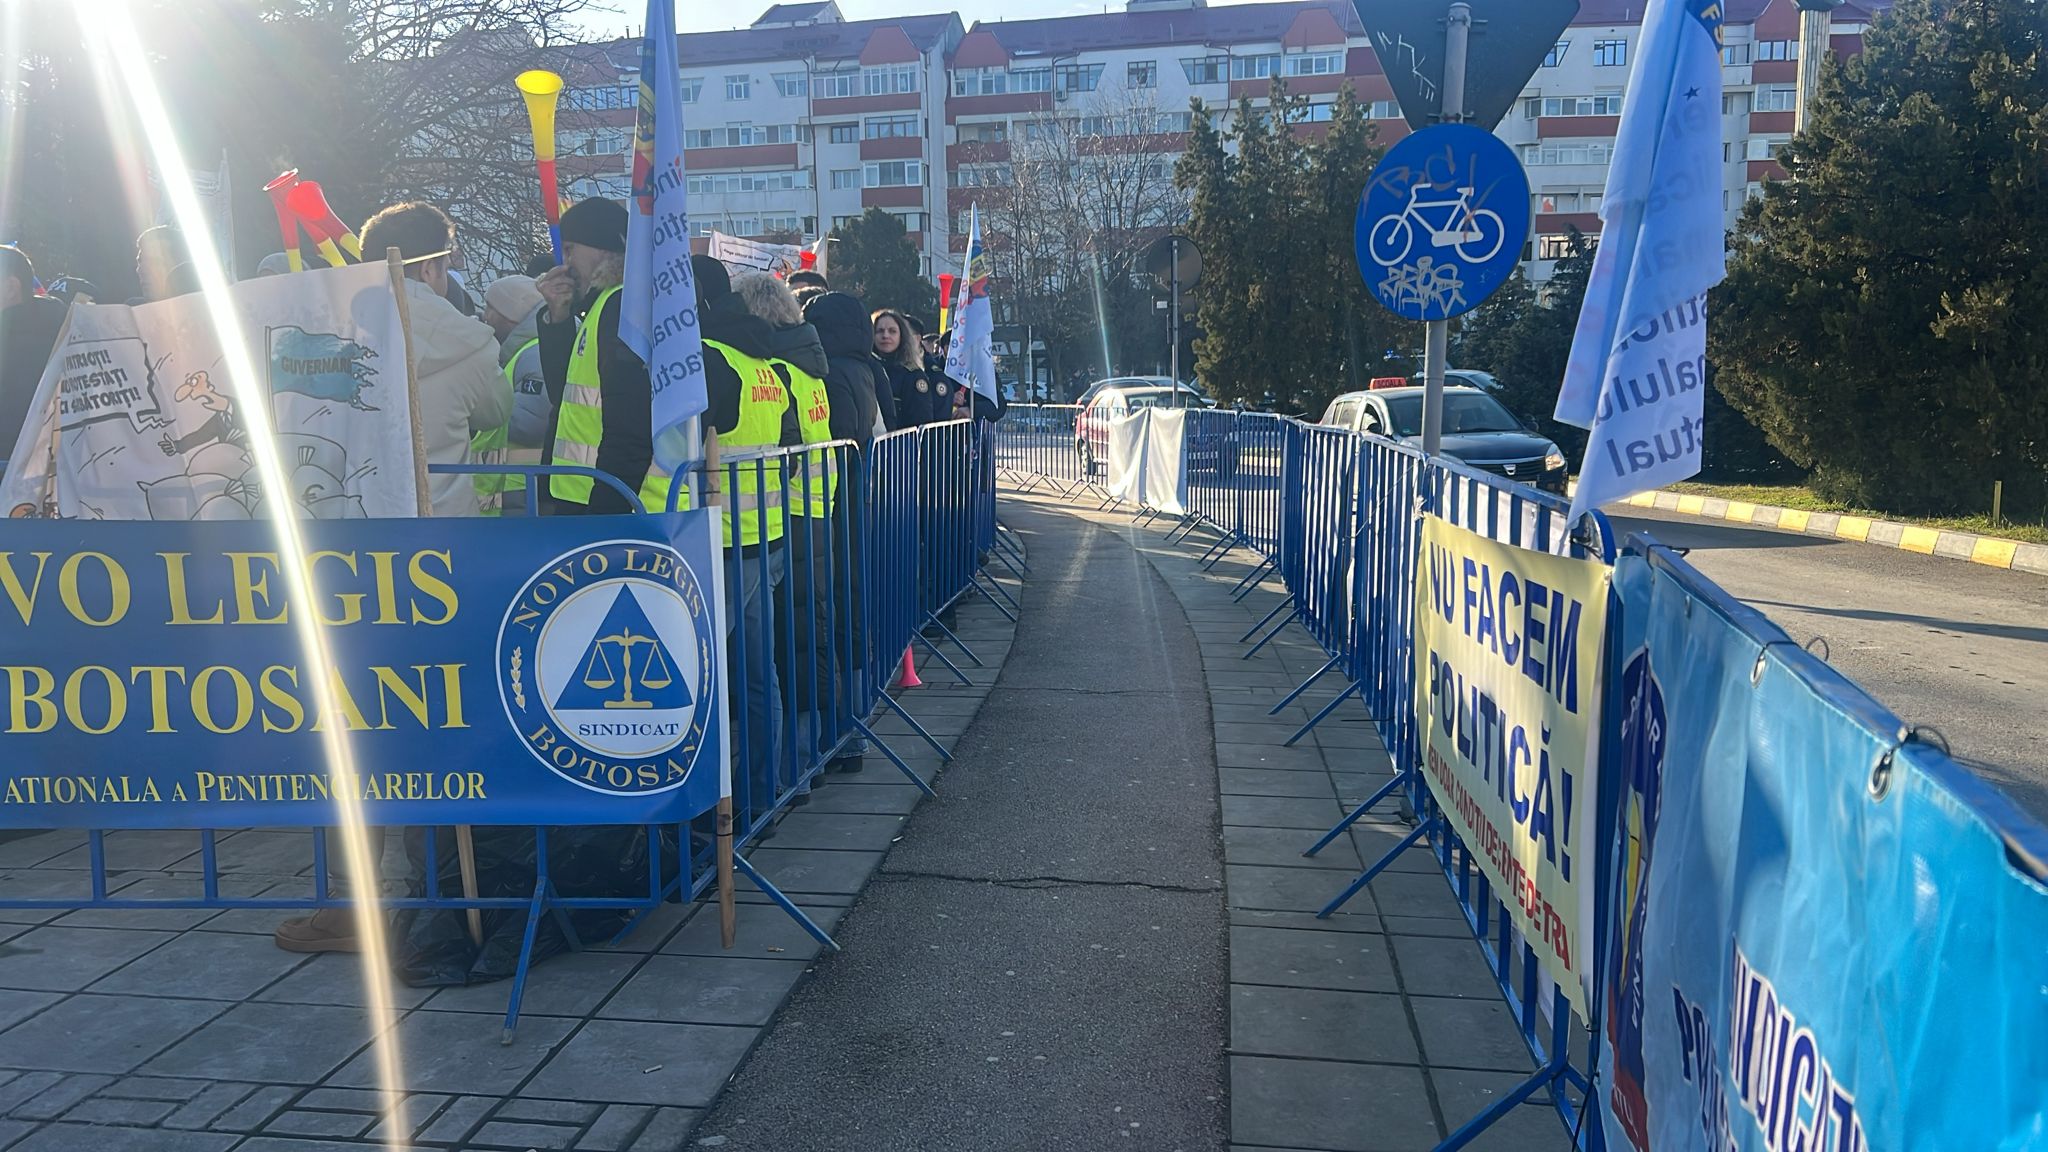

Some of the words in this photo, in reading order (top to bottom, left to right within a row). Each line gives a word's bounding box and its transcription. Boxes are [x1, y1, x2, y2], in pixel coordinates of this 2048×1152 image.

[155, 550, 459, 627] LEGIS
[513, 552, 609, 633] NOVO
[623, 549, 702, 619] LEGIS
[1429, 541, 1455, 625] NU
[1463, 556, 1582, 714] FACEM
[1, 663, 471, 735] BOTOSANI
[578, 722, 680, 737] SINDICAT
[1429, 648, 1573, 883] POLITICĂ!
